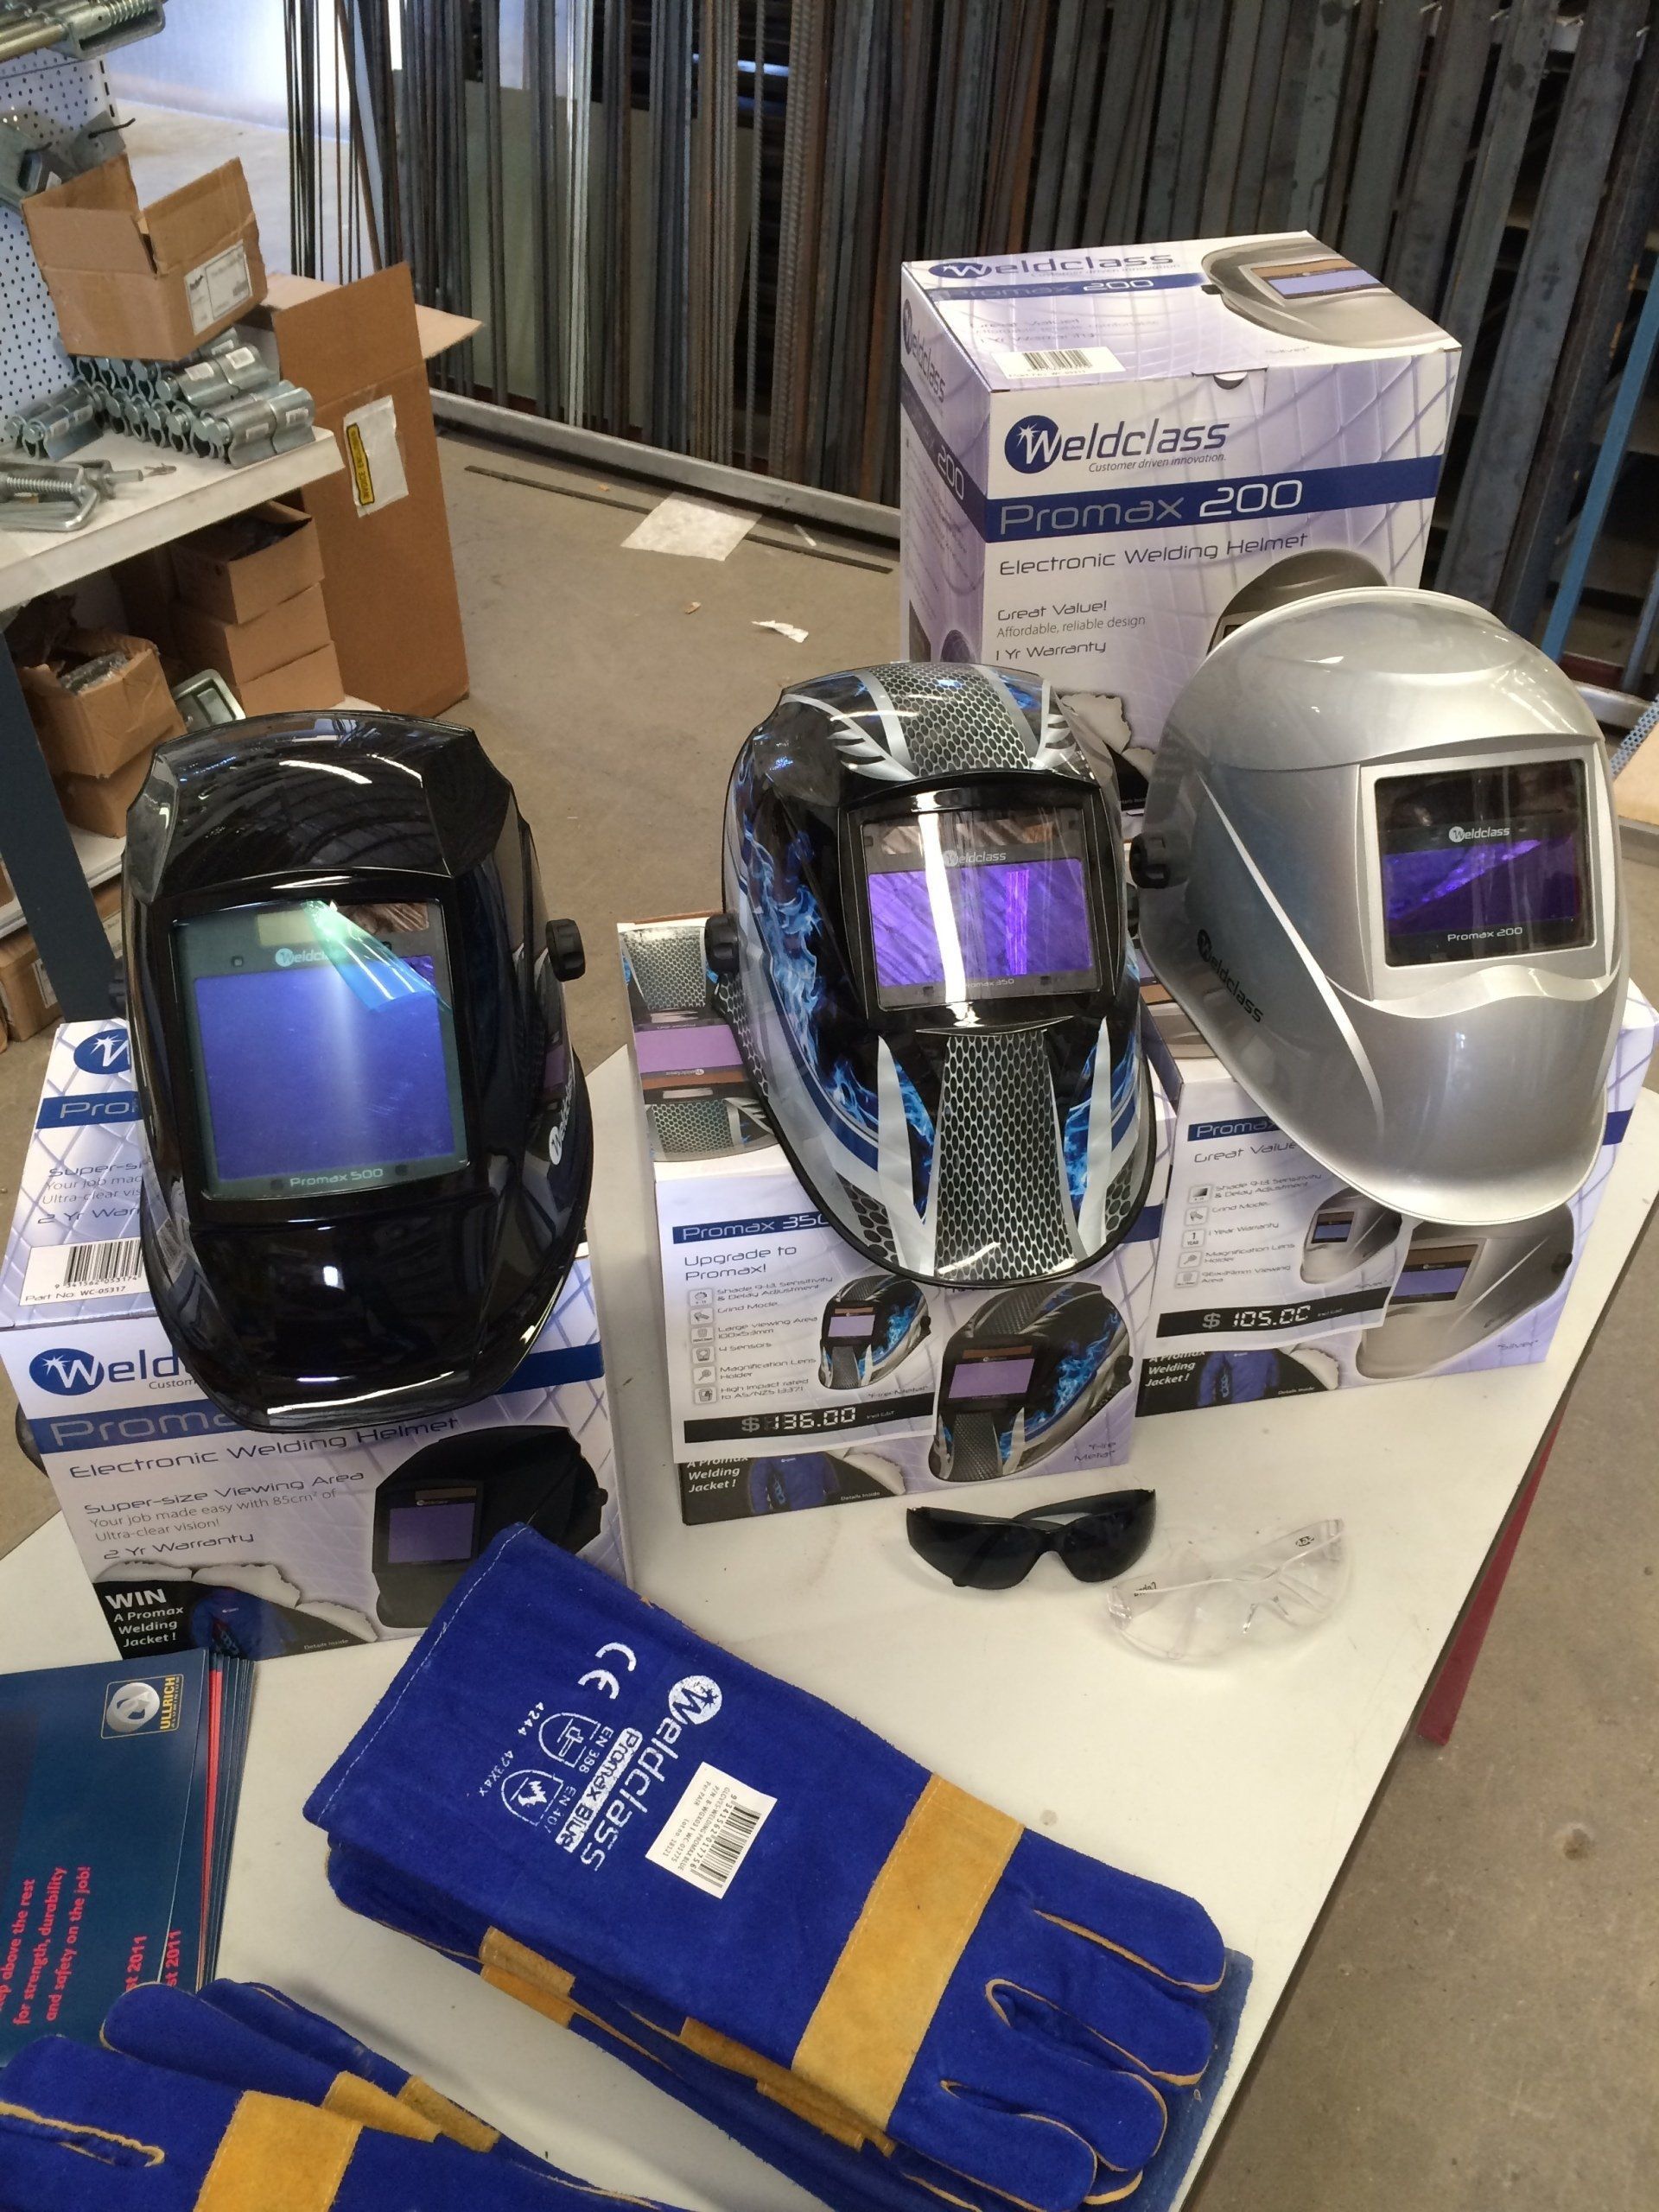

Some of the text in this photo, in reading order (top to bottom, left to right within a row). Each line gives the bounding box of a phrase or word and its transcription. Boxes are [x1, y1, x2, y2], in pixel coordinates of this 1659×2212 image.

[929, 255, 1173, 279] Weldclass
[1083, 279, 1154, 292] 200
[1005, 416, 1230, 472] Weldclass
[938, 447, 964, 501] 200
[1089, 453, 1227, 474] Customer driven innovation.
[1000, 479, 1304, 536] Promax 200
[1000, 532, 1308, 576] Electronic Welding Helmet
[997, 601, 1108, 621] Great Value!
[996, 614, 1146, 639] Affordable, reliable design
[1005, 641, 1107, 660] Yr Warranty
[1448, 826, 1510, 843] Weldclass
[943, 849, 1007, 868] Weldclass
[1447, 926, 1523, 942] Promax 200
[1197, 929, 1263, 1023] Weldclass
[1196, 1120, 1277, 1138] Promax
[1194, 1148, 1244, 1163] Great
[46, 1181, 79, 1192] Your
[82, 1178, 106, 1189] job
[289, 1167, 384, 1188] Promax 500
[1255, 1181, 1308, 1192] Adjustment
[42, 1190, 118, 1205] Ultra-clear
[38, 1213, 54, 1224] 2
[64, 1211, 86, 1222] Yr
[683, 1221, 775, 1241] Promax
[684, 1246, 797, 1267] Upgrade to
[685, 1263, 766, 1281] Promax!
[80, 1286, 126, 1297] WC-05317
[717, 1286, 753, 1295] Shade
[728, 1291, 759, 1300] Delay
[760, 1284, 819, 1296] Adjustment
[717, 1304, 745, 1313] Grind
[718, 1324, 749, 1333] Large
[1202, 1311, 1221, 1329] $
[720, 1360, 788, 1373] Magnification
[720, 1371, 753, 1380] Holder
[1148, 1362, 1196, 1375] Welding
[721, 1385, 744, 1394] High
[1145, 1375, 1184, 1388] Jacket
[741, 1406, 856, 1433] $ 136.00
[69, 1417, 458, 1478] Electronic Welding Helmet
[688, 1467, 741, 1481] Welding
[84, 1471, 365, 1516] Super-size Viewing Area
[688, 1480, 730, 1494] Jacket
[89, 1515, 123, 1528] Your
[126, 1510, 151, 1525] job
[161, 1504, 198, 1519] made
[200, 1504, 233, 1517] easy
[237, 1495, 269, 1510] with
[321, 1488, 338, 1500] of
[95, 1518, 220, 1542] Ultra-clear vision!
[104, 1531, 255, 1560] 2 Yr Warranty
[105, 1587, 167, 1610] WIN
[112, 1605, 184, 1623] A Promax
[118, 1619, 178, 1635] Welding
[123, 1633, 170, 1649] Jacket
[578, 1642, 637, 1700] CE
[160, 1676, 176, 1730] ULLRICH
[518, 1701, 545, 1737] 4244
[579, 1726, 614, 1773] EN 388
[581, 1675, 722, 1872] Weldclass
[558, 1785, 577, 1807] EN
[559, 1730, 640, 1848] Promax Blue
[710, 1802, 733, 1835] 341562
[690, 1836, 713, 1870] 017756
[1, 1938, 22, 1980] above
[12, 1910, 29, 1935] the
[21, 1878, 35, 1907] rest
[13, 1866, 68, 2025] for strength, durability
[46, 1866, 91, 2021] and safety on the job!
[165, 1929, 181, 1968] 2011
[128, 1936, 148, 1973] 2011
